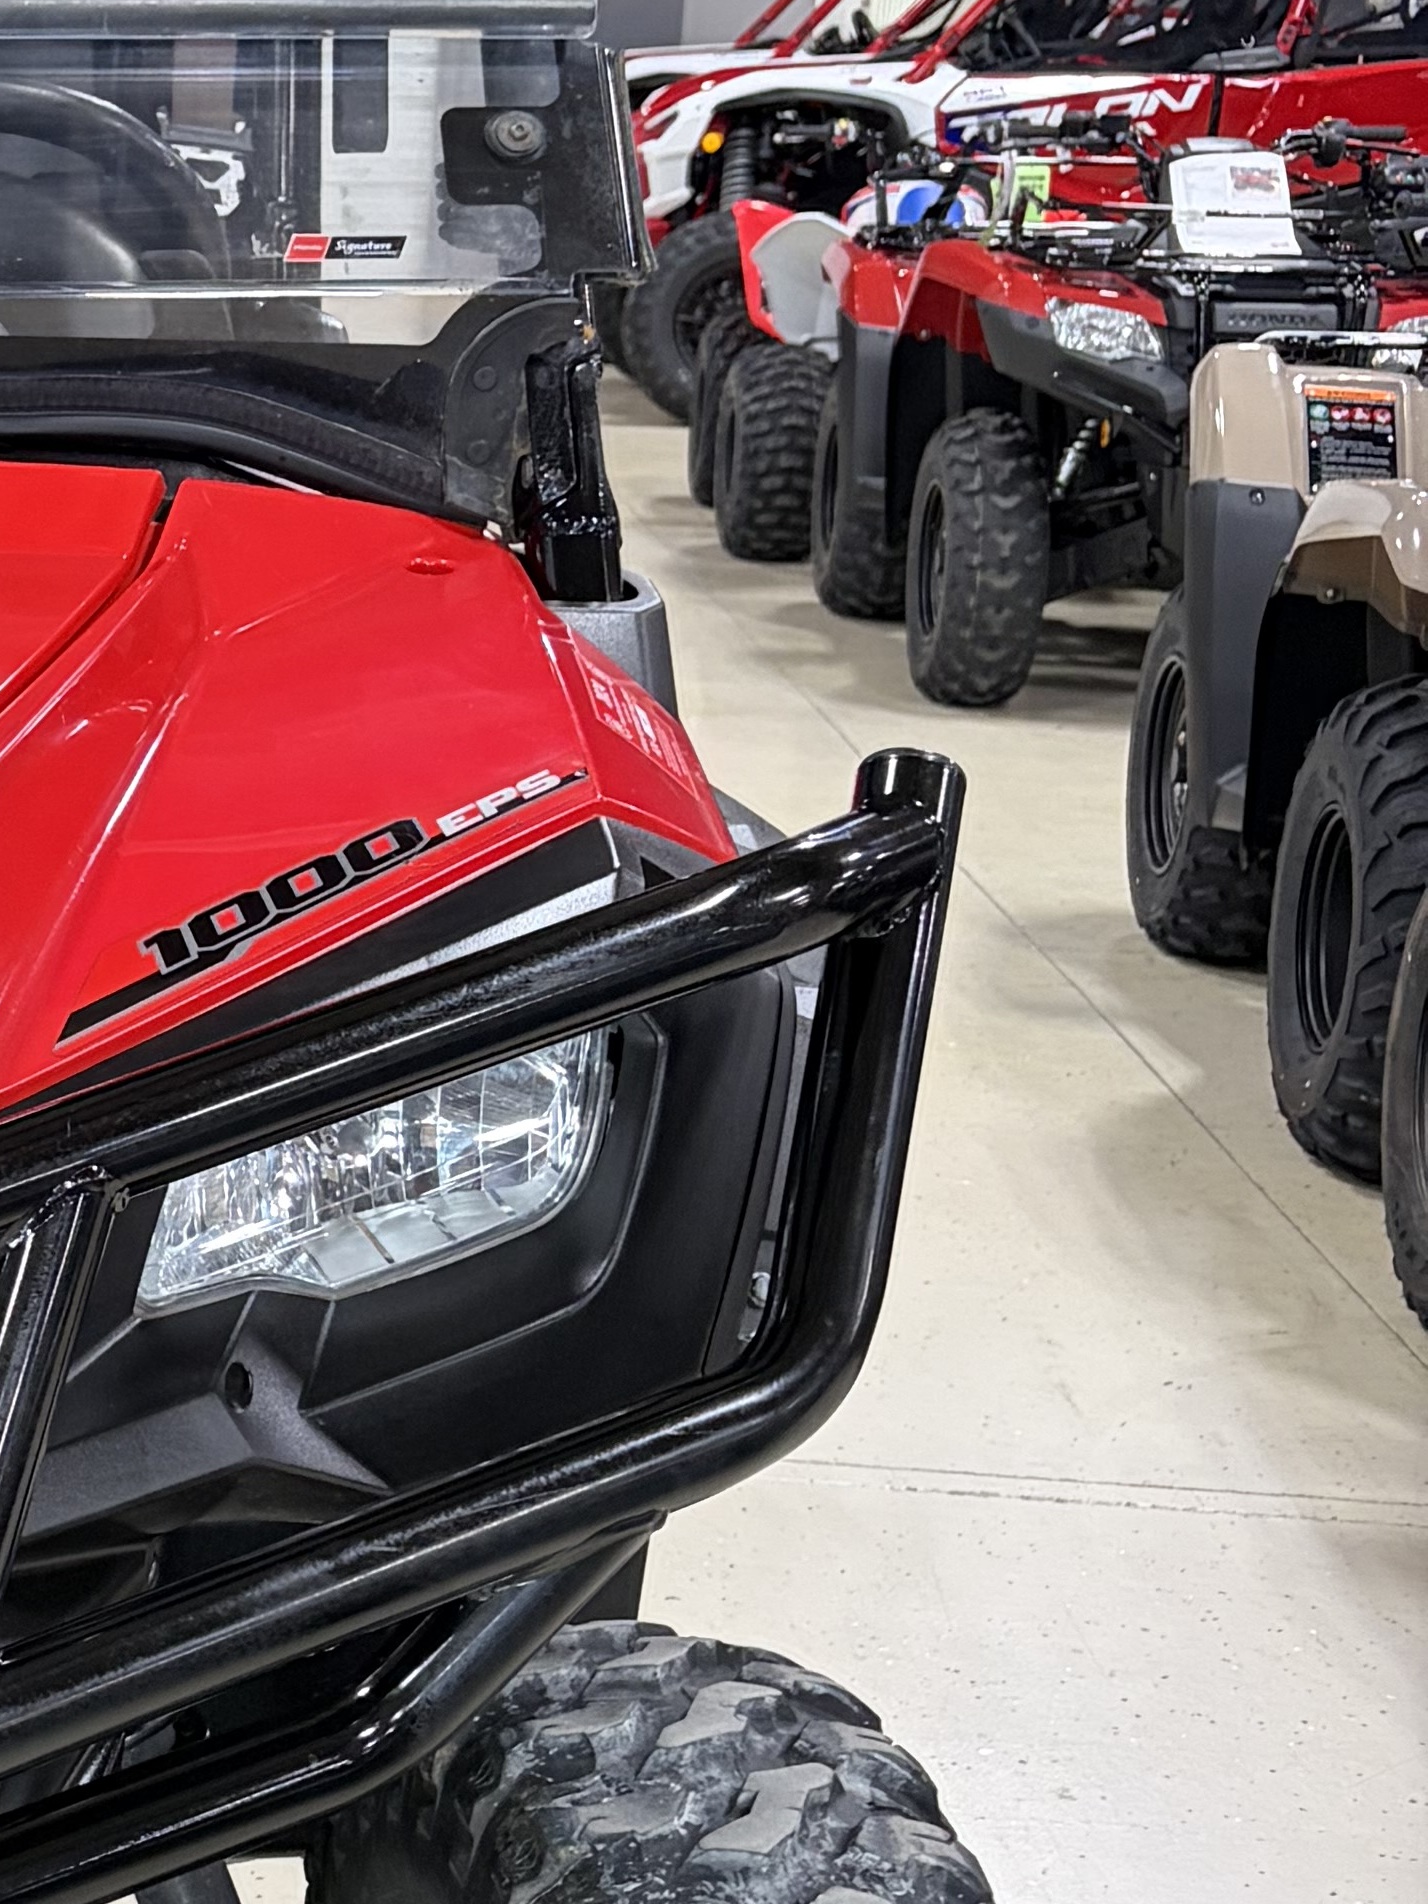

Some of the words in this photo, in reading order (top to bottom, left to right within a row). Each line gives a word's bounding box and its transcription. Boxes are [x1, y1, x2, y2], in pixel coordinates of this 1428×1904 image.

[334, 239, 393, 255] Signature
[138, 817, 431, 975] 1000
[435, 768, 561, 838] EPS
